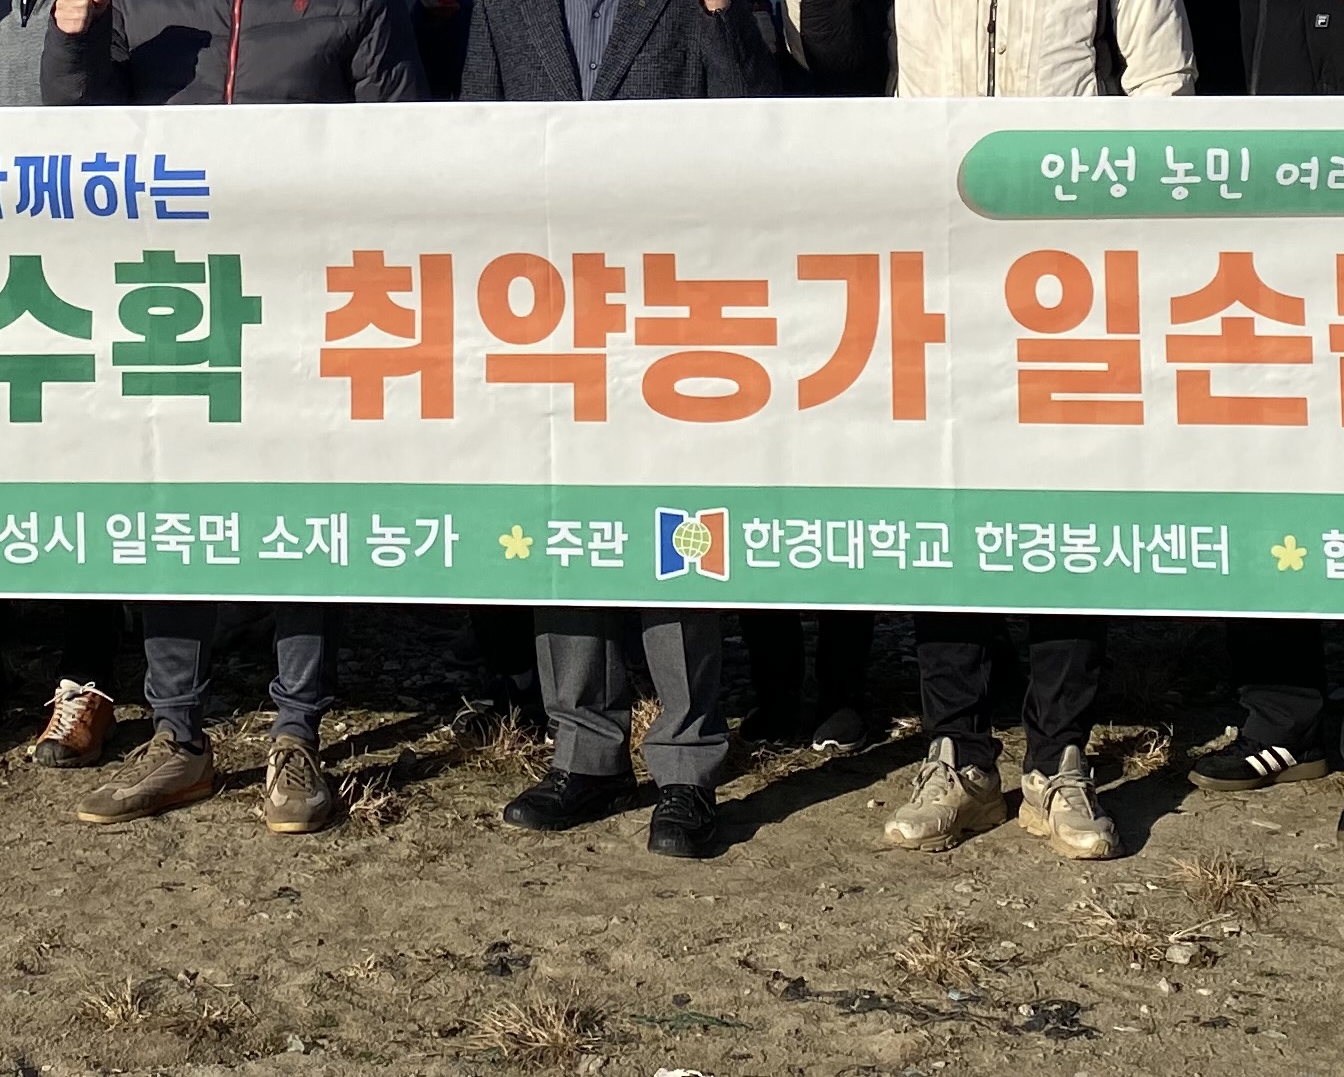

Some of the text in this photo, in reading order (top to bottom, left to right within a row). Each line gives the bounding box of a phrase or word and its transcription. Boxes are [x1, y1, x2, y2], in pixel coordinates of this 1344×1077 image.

[1040, 146, 1136, 201] 안성
[1160, 145, 1250, 200] 농민
[319, 249, 947, 423] 취약농가
[106, 511, 240, 565] 일죽면
[258, 512, 348, 566] 소재
[366, 514, 460, 568] 농가
[545, 517, 1229, 575] 주관 한경대학교 한경봉사센터
